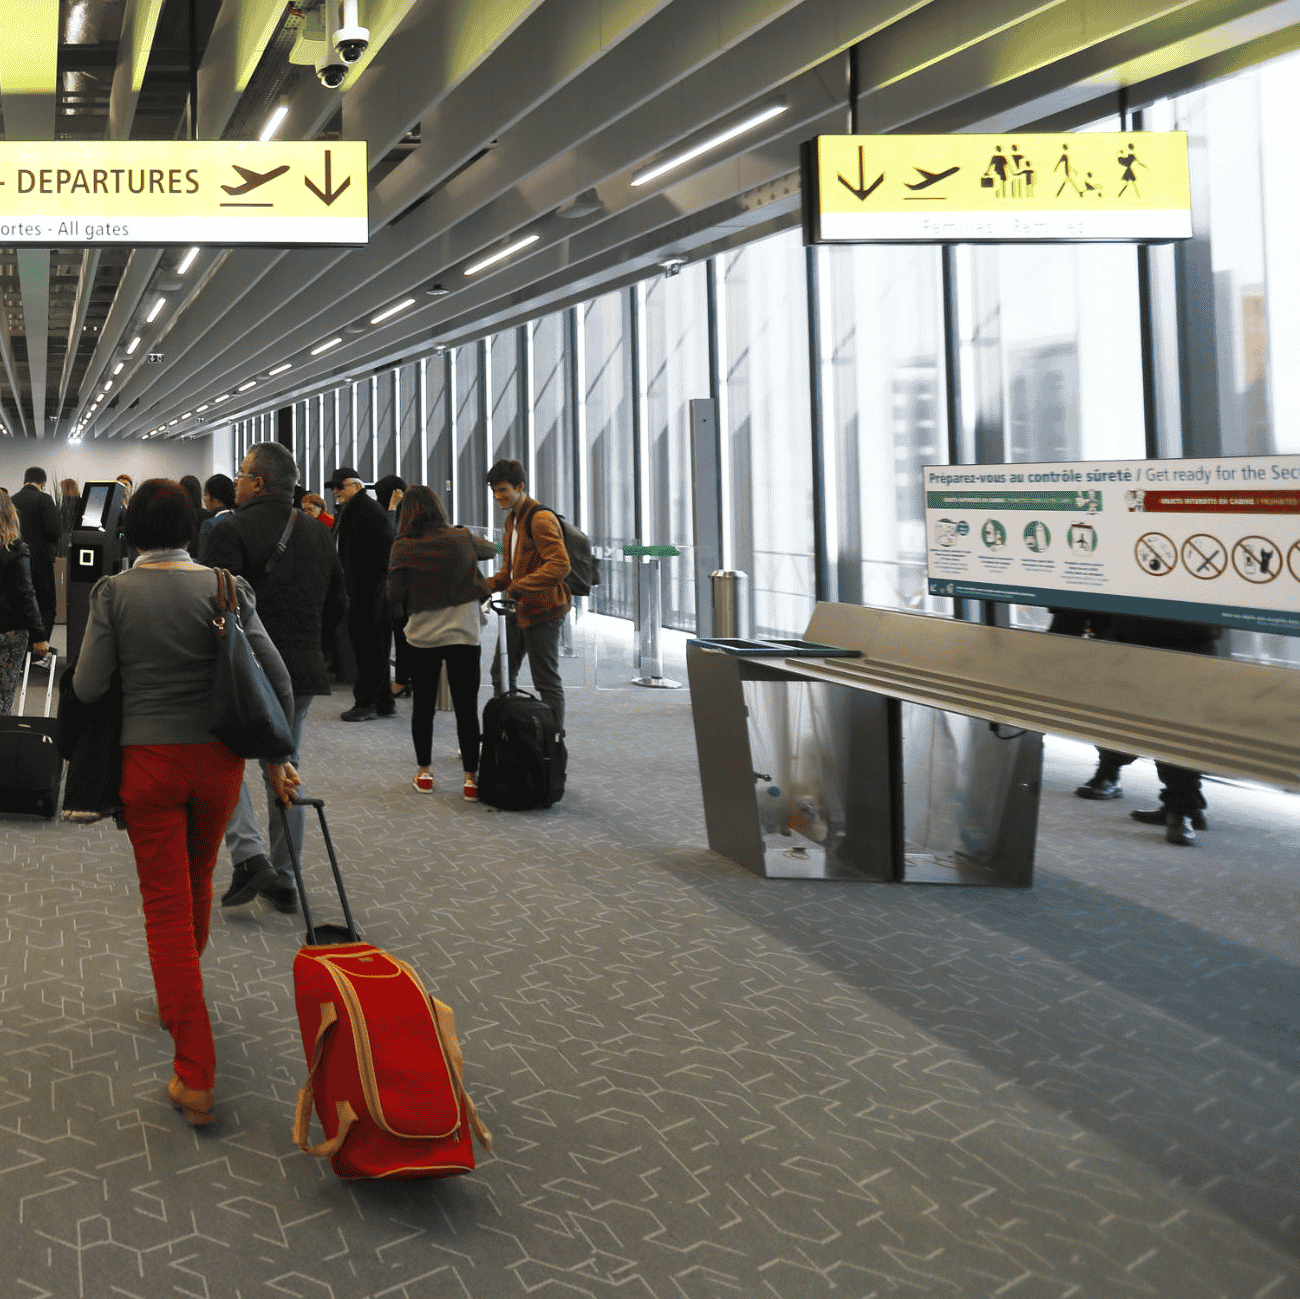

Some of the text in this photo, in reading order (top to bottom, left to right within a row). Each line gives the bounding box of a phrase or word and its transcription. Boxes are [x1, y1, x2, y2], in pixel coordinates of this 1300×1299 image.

[17, 169, 200, 195] DEPARTURES
[58, 221, 79, 236] All
[85, 223, 130, 240] gates
[929, 472, 1006, 487] Préparez-vous
[1009, 473, 1025, 483] au
[1027, 469, 1082, 483] contrôle
[1086, 468, 1133, 482] sûreté
[1145, 467, 1170, 482] Get
[1173, 465, 1212, 484] ready
[1216, 465, 1237, 481] for
[1241, 465, 1267, 480] the
